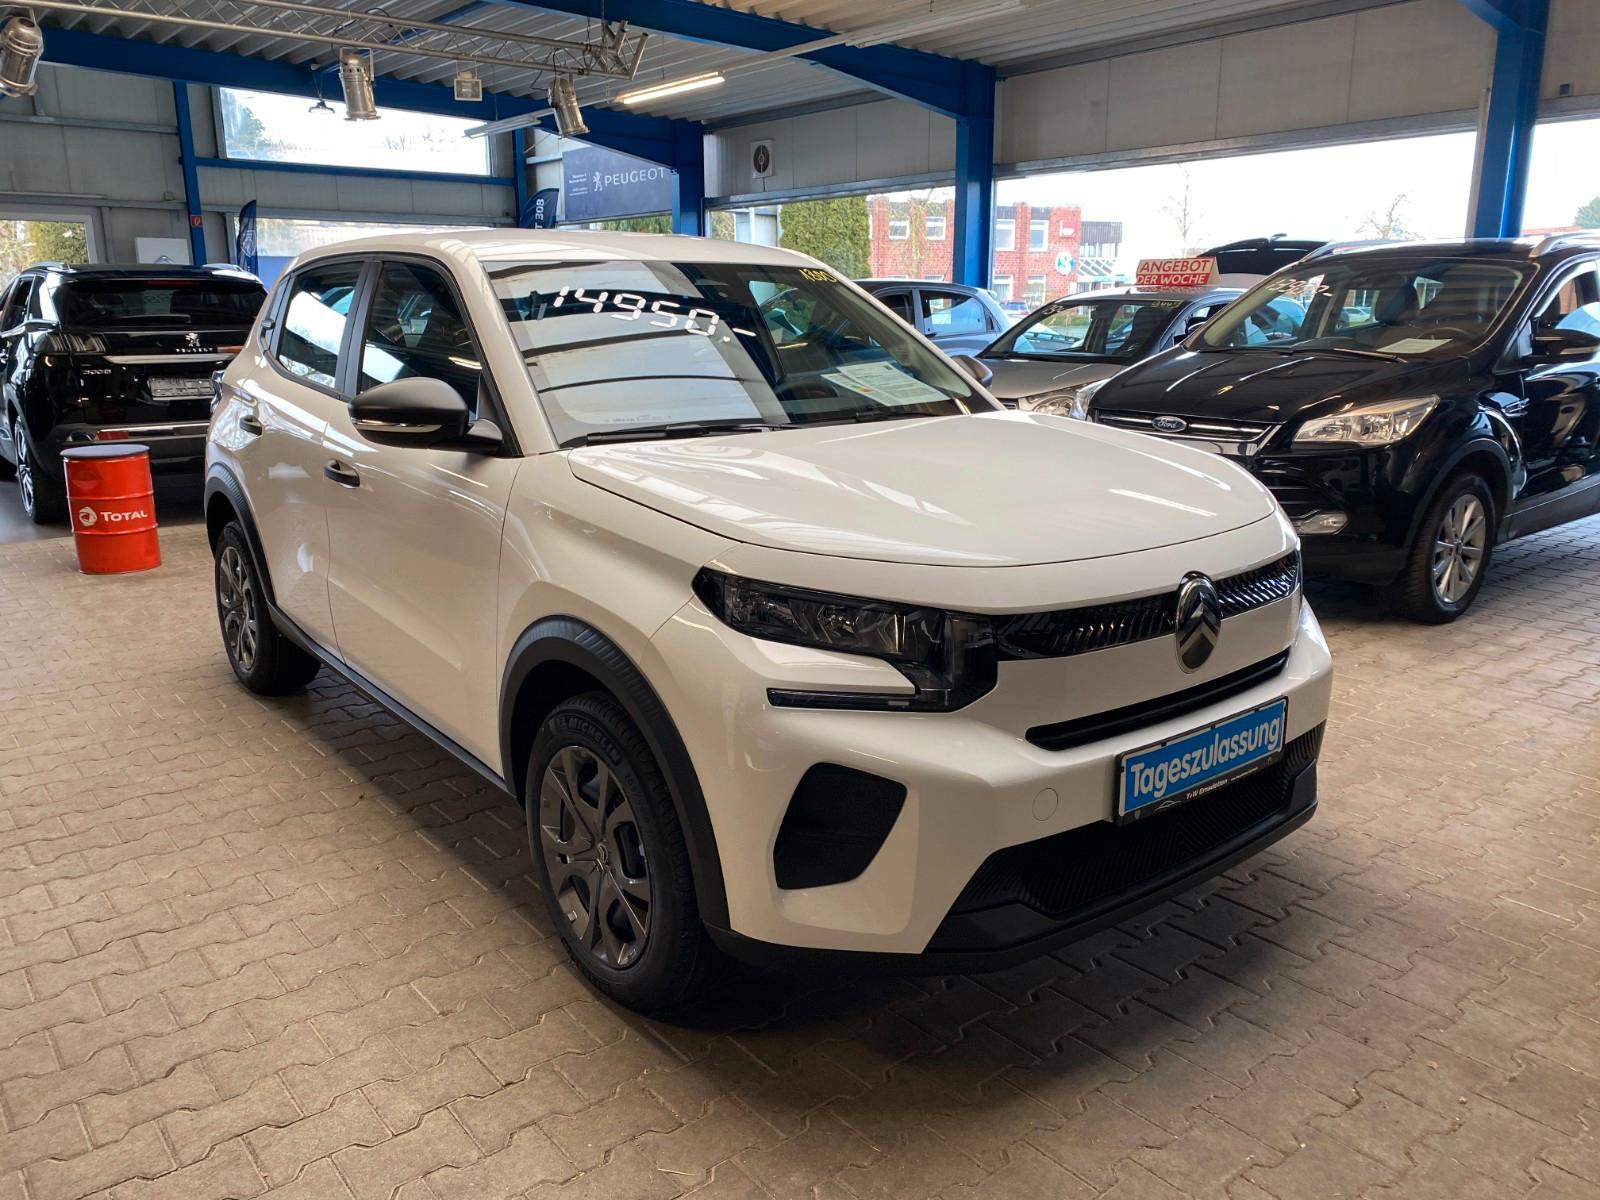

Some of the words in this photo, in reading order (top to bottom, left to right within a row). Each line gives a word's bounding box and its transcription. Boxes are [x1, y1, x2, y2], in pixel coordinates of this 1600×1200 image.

[604, 167, 665, 187] PEUGEOT
[535, 198, 544, 221] 308
[1140, 260, 1210, 273] ANGEBOT
[1137, 275, 1158, 284] DER
[1161, 274, 1206, 284] WOCHE
[568, 717, 621, 763] MICHELIN
[1131, 717, 1280, 798] Tageszulassung
